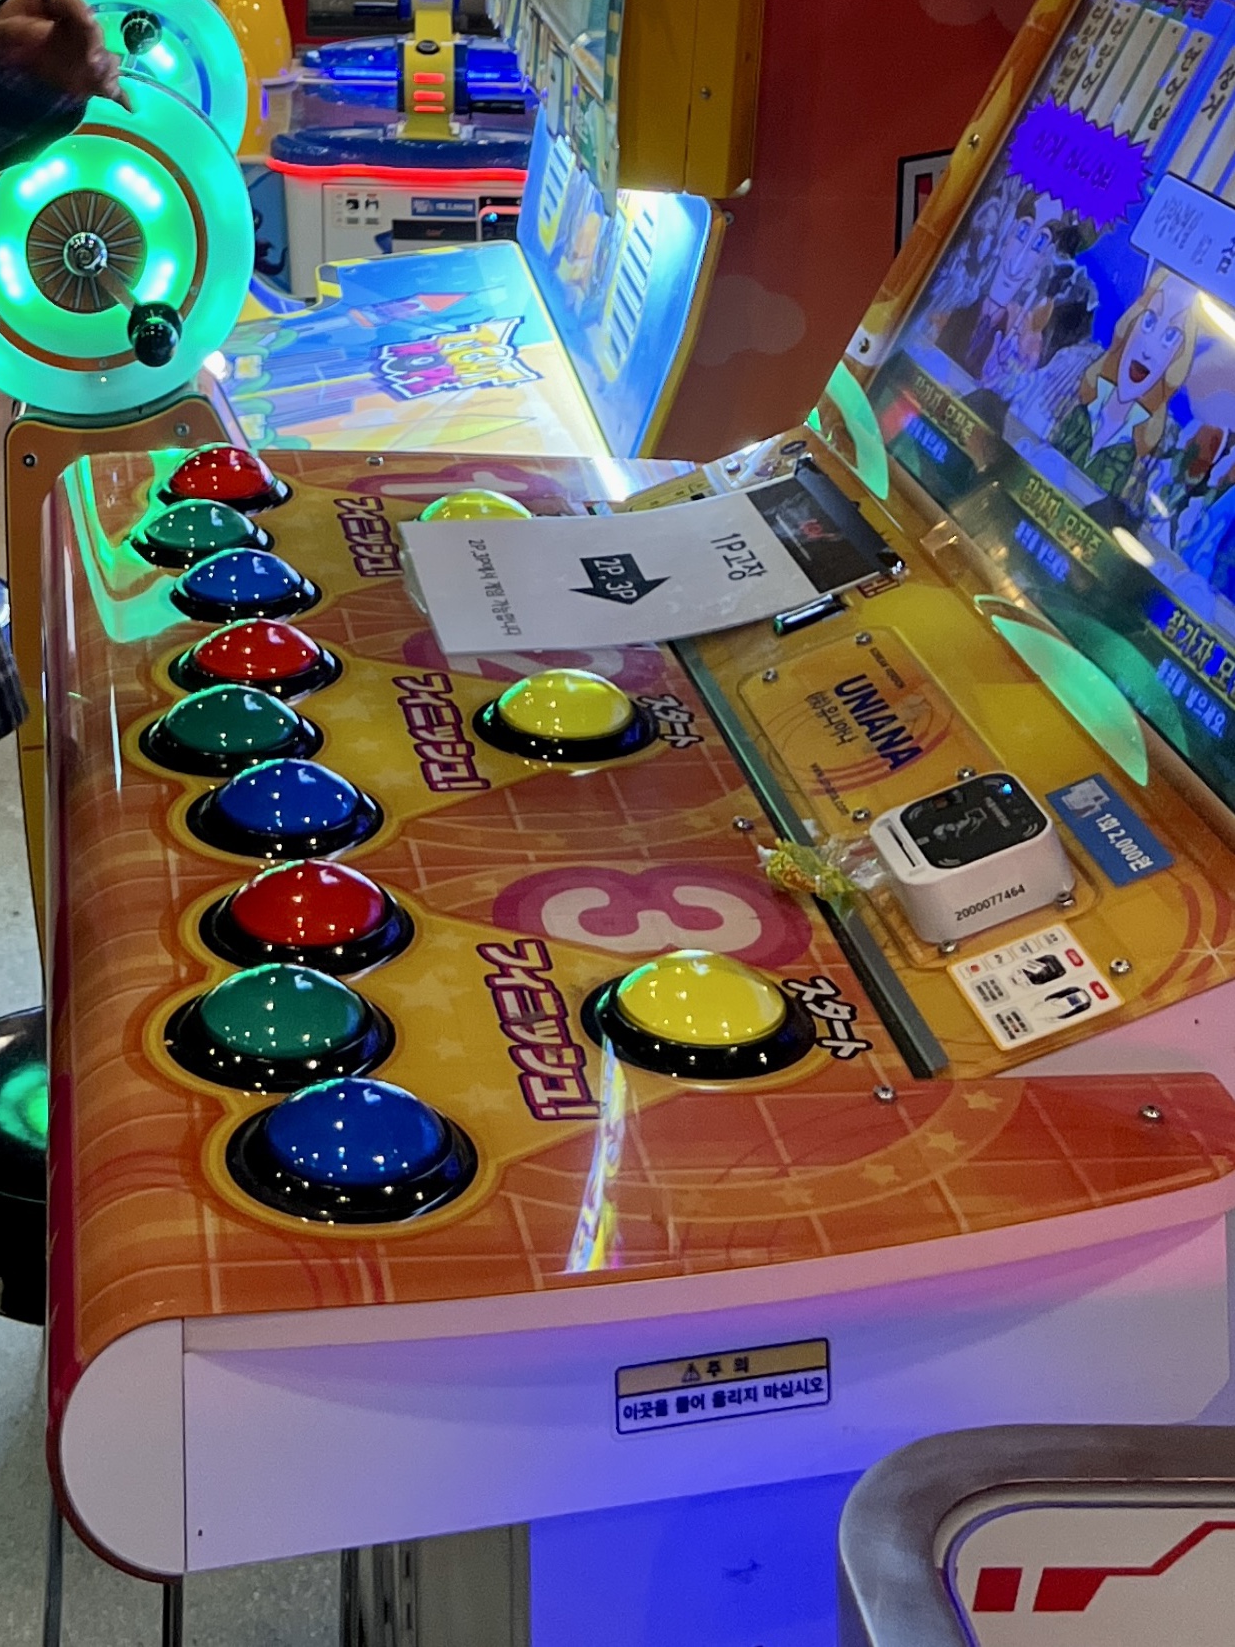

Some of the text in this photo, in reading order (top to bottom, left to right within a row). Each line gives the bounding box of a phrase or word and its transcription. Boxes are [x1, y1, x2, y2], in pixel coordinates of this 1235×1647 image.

[710, 532, 768, 582] 1P고장
[605, 580, 638, 601] 3P
[1167, 608, 1216, 669] 참가자
[636, 692, 705, 749] スタート
[832, 673, 924, 773] UNIANA
[1093, 812, 1155, 873] 1회 2,000원
[541, 885, 763, 955] 3
[953, 883, 1027, 922] 2000077464
[476, 938, 604, 1121] フィニッシュ!
[782, 975, 873, 1060] スタート
[705, 1356, 750, 1378] 주 의
[623, 1399, 669, 1421] 이곳을
[711, 1385, 759, 1409] 올리지
[763, 1376, 825, 1400] 마십시오
